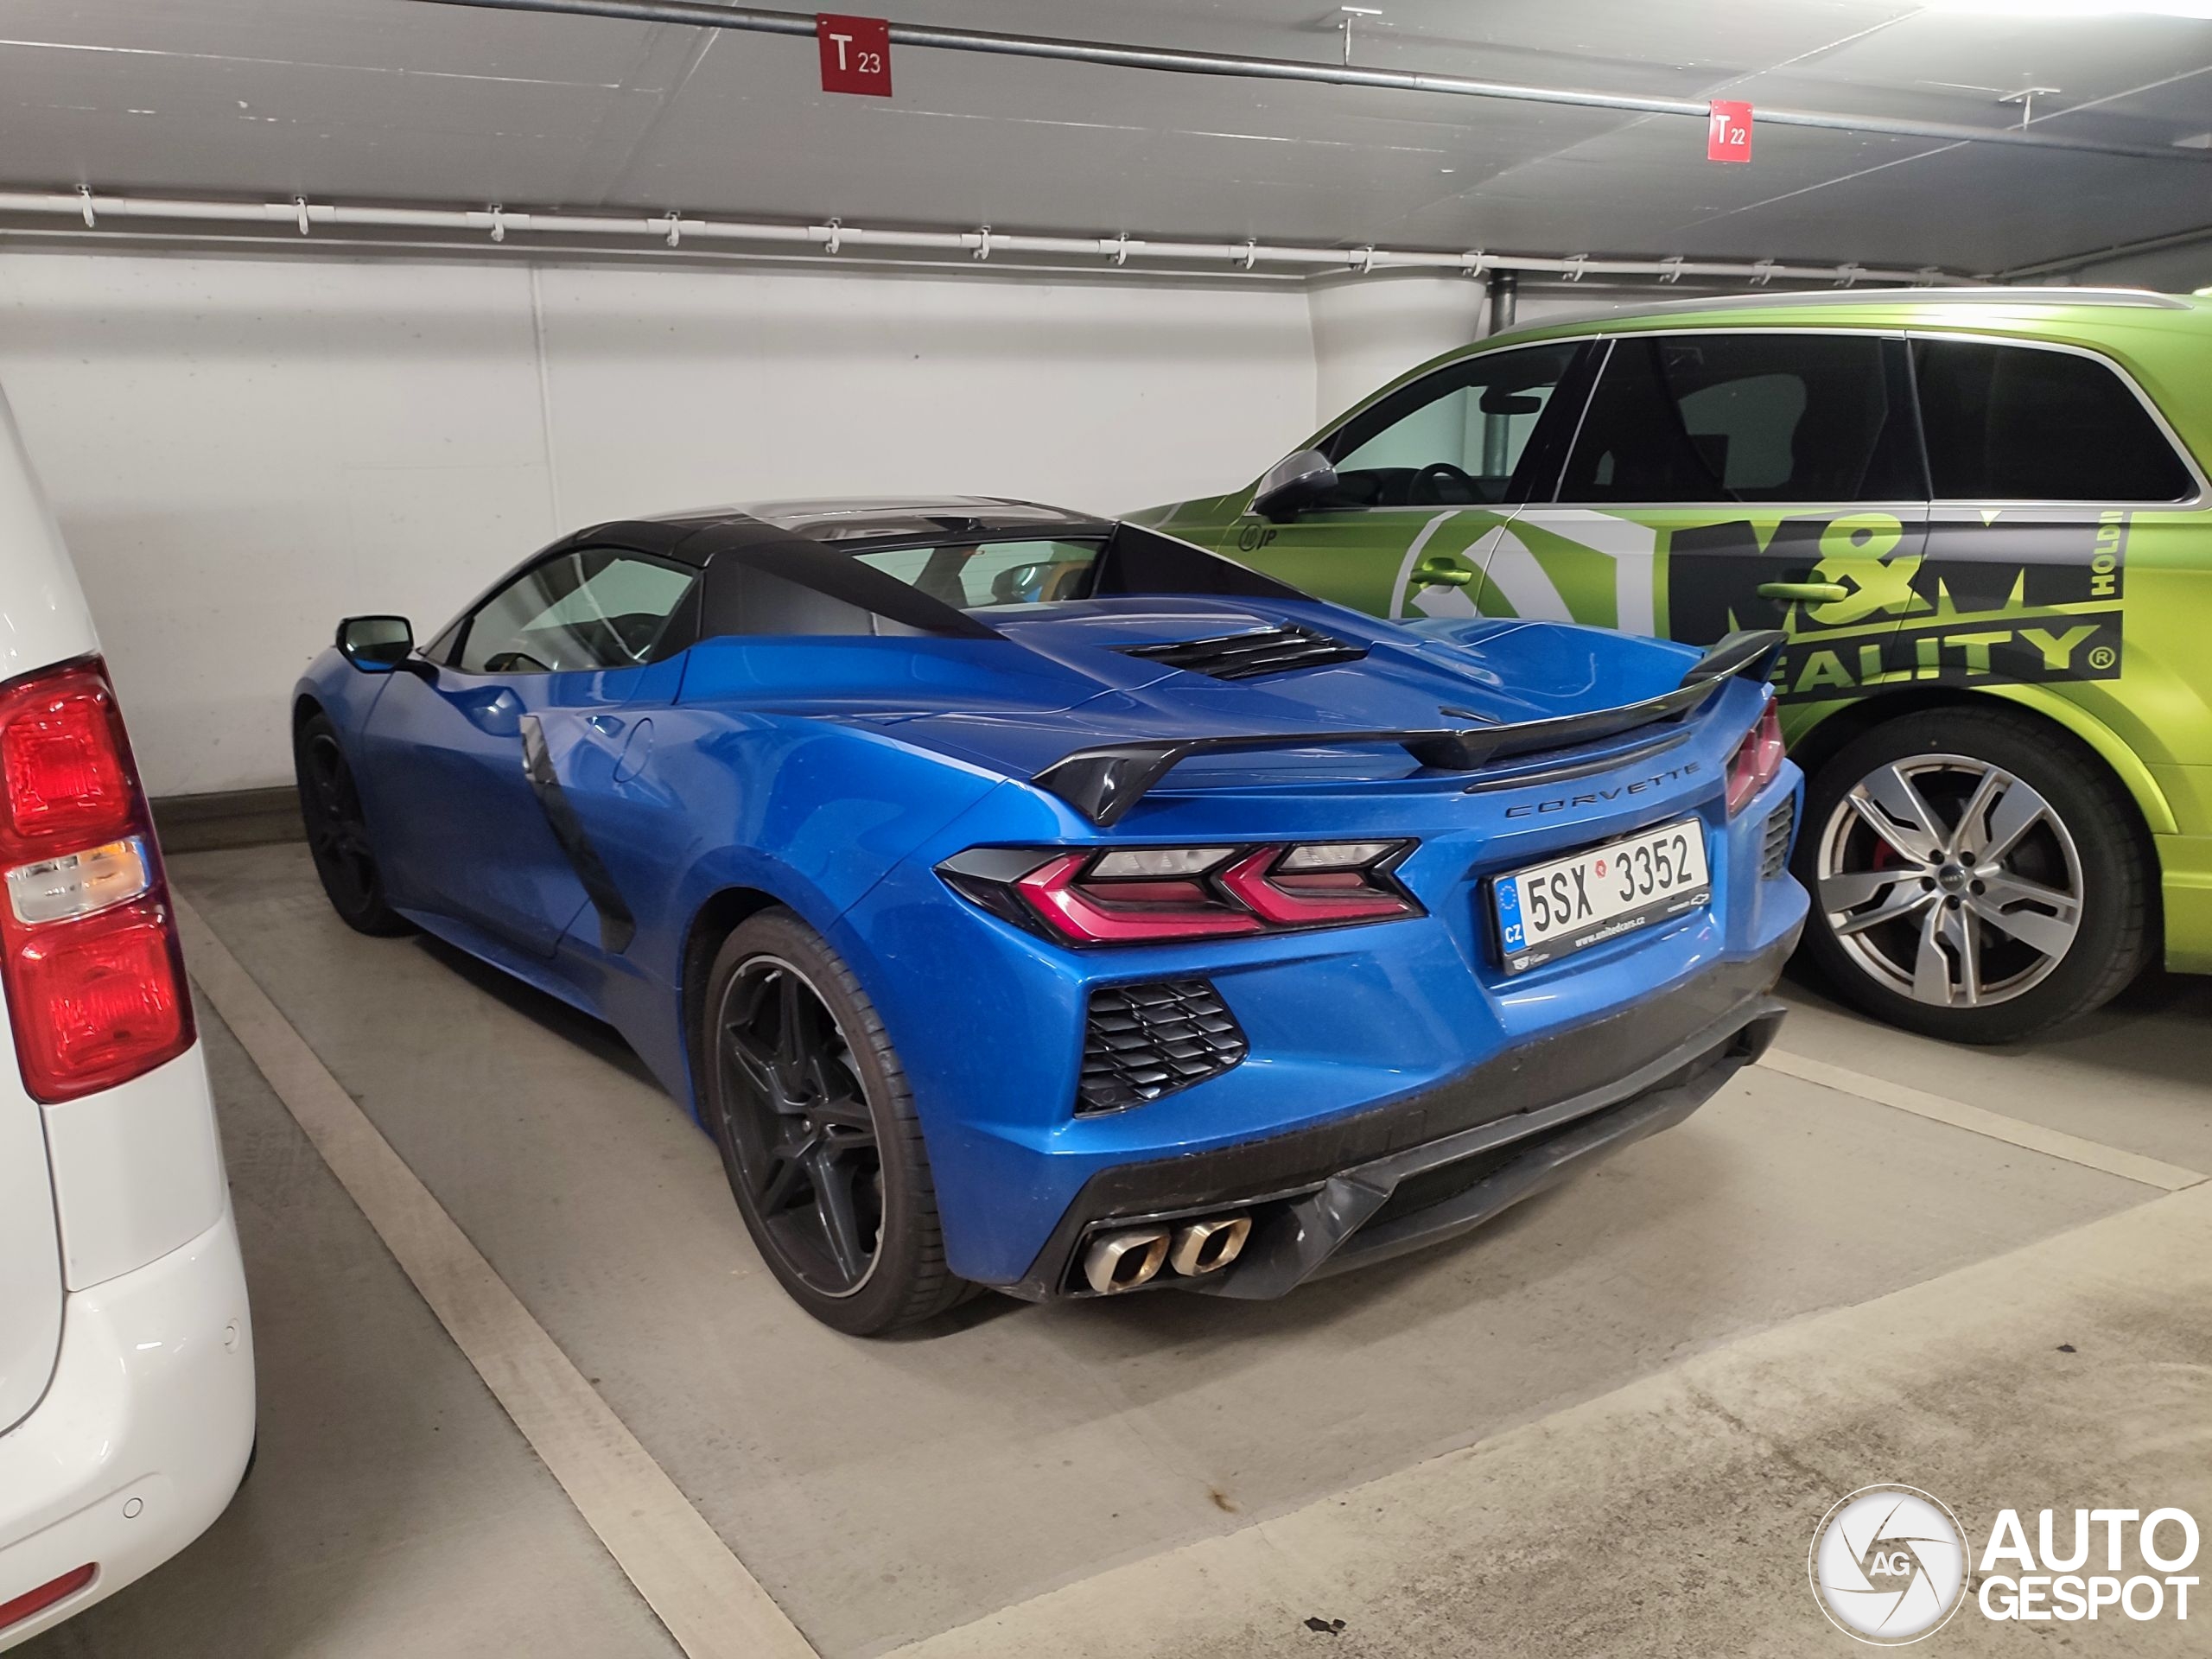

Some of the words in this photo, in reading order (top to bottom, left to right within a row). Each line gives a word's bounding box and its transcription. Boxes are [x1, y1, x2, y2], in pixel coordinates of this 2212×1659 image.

[830, 34, 853, 71] T
[857, 52, 881, 73] 23
[1715, 114, 1731, 143] T
[1730, 128, 1745, 145] 22
[1505, 761, 1701, 818] CORVETTE
[1527, 864, 1593, 932] 5SX
[1615, 835, 1693, 902] 3352
[1504, 924, 1522, 944] CZ
